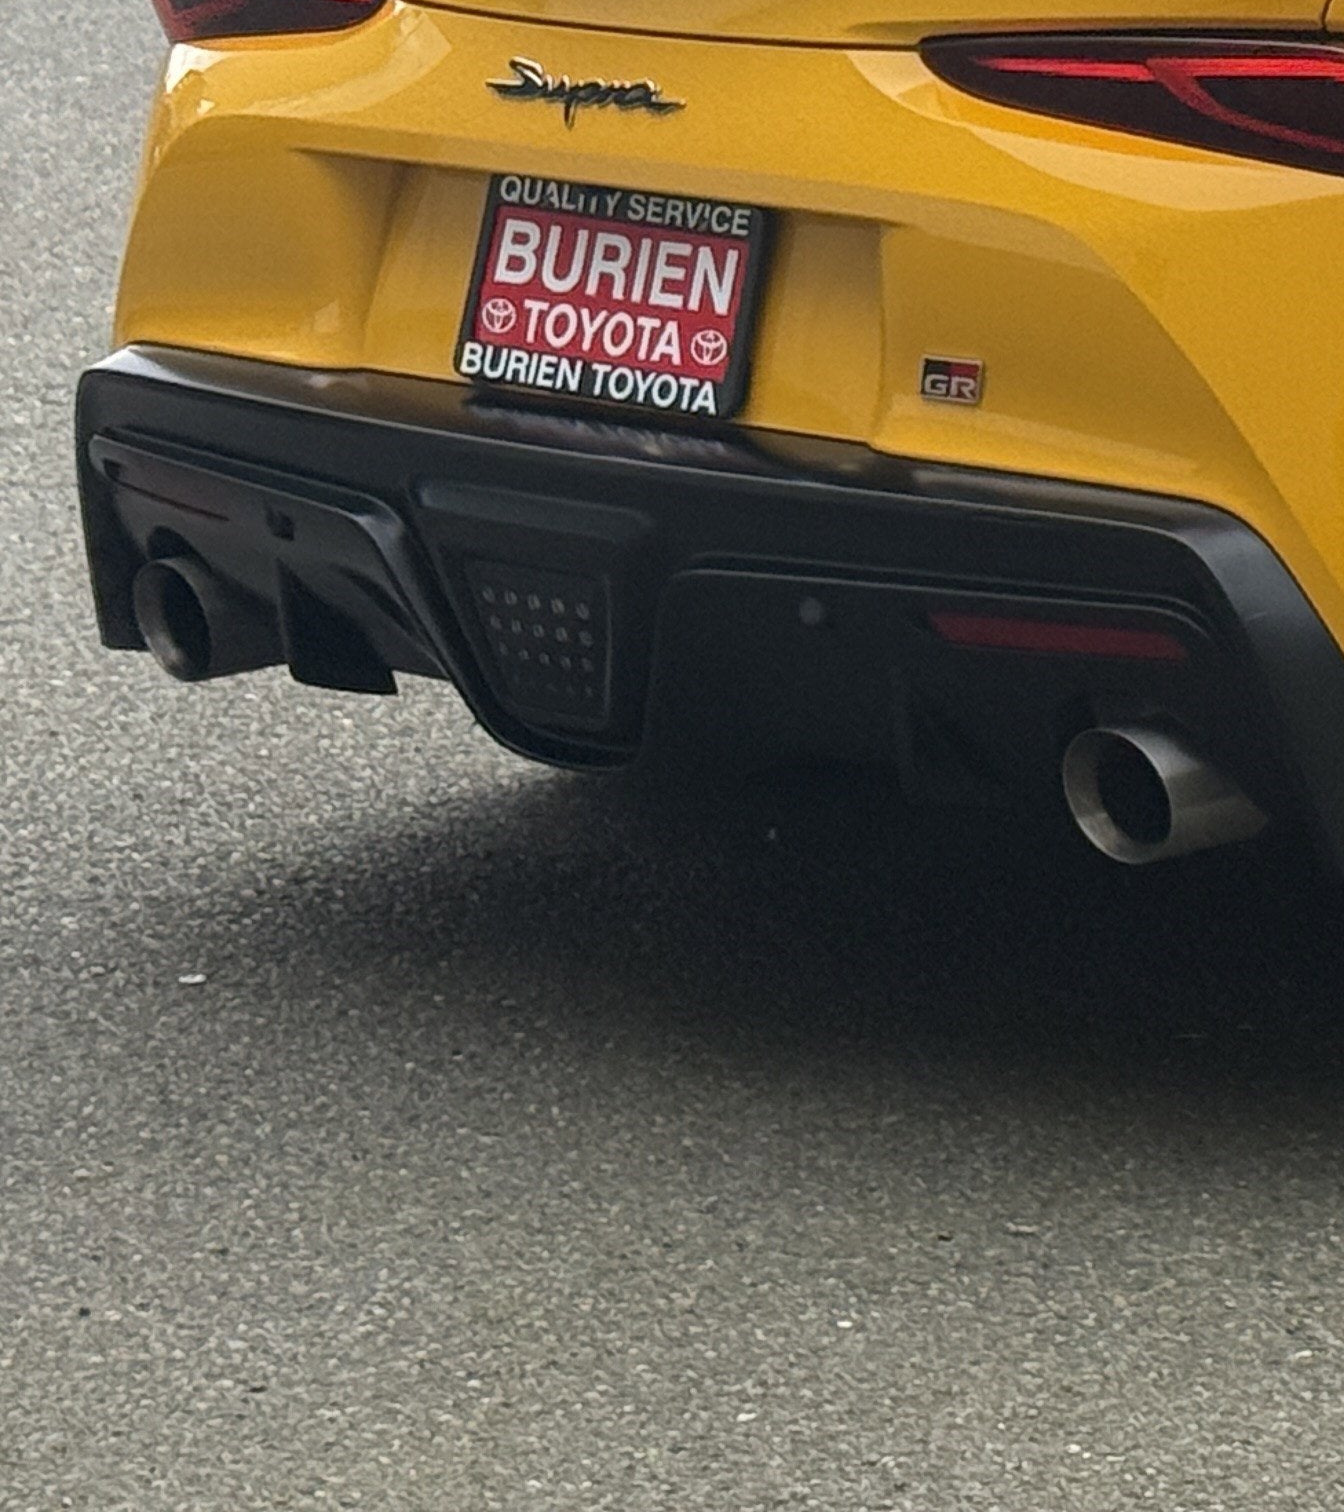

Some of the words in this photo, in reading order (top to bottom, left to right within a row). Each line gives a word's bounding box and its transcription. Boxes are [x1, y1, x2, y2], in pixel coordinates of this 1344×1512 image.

[485, 55, 687, 131] Supra
[627, 193, 751, 237] SERVICE
[494, 217, 739, 316] BURIEN
[523, 298, 682, 366] TOYOTA
[459, 341, 584, 393] BURIEN
[591, 361, 717, 416] TOYOTA
[924, 374, 977, 402] GR
